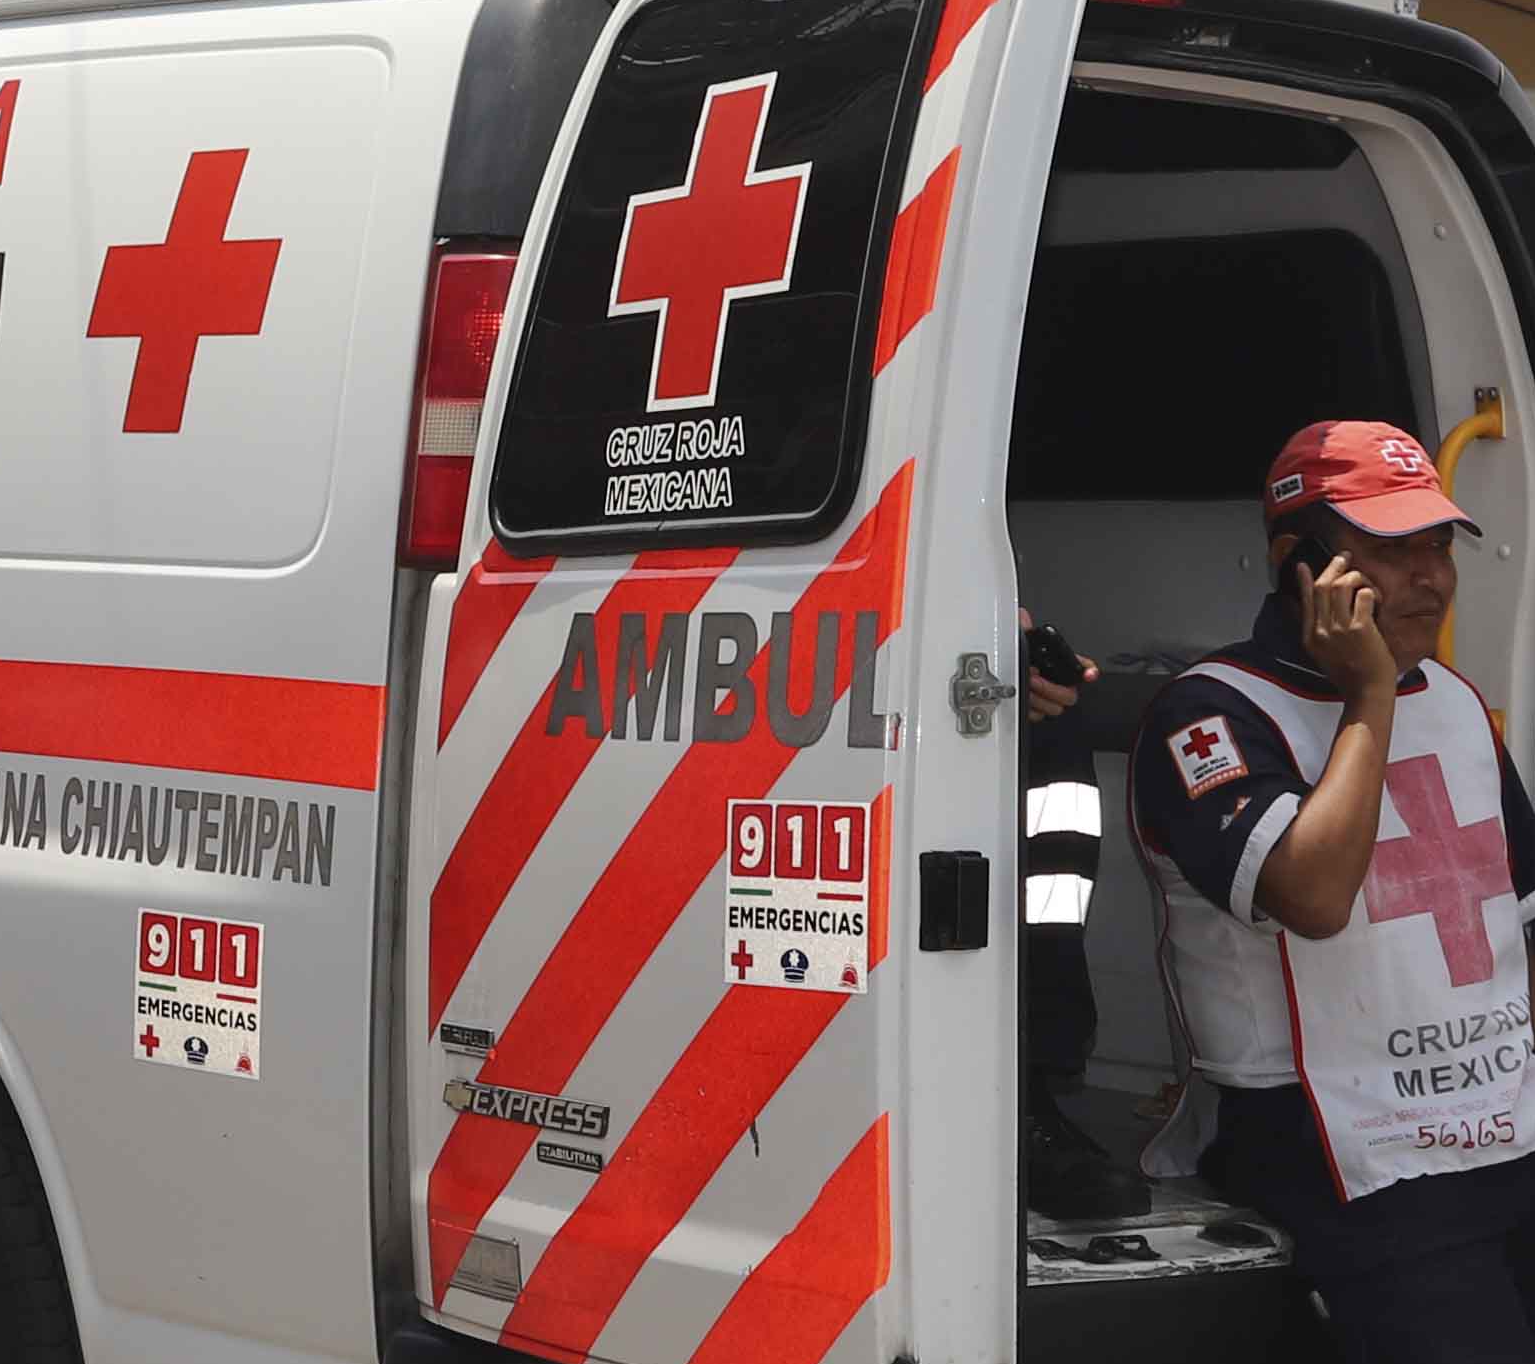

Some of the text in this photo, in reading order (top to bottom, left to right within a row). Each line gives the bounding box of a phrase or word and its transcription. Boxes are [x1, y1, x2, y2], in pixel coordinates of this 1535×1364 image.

[605, 416, 745, 467] CRUZ ROJA
[605, 467, 733, 517] MEXICANA
[544, 611, 898, 751] AMBUL
[59, 776, 336, 886] CHIAUTEMPAN
[738, 813, 852, 869] 911
[728, 906, 865, 937] EMERGENCIAS
[145, 921, 249, 984] 911
[137, 996, 258, 1034] EMERGENCIAS
[1387, 1014, 1487, 1057] CRUZ
[472, 1088, 605, 1136] EXPRESS
